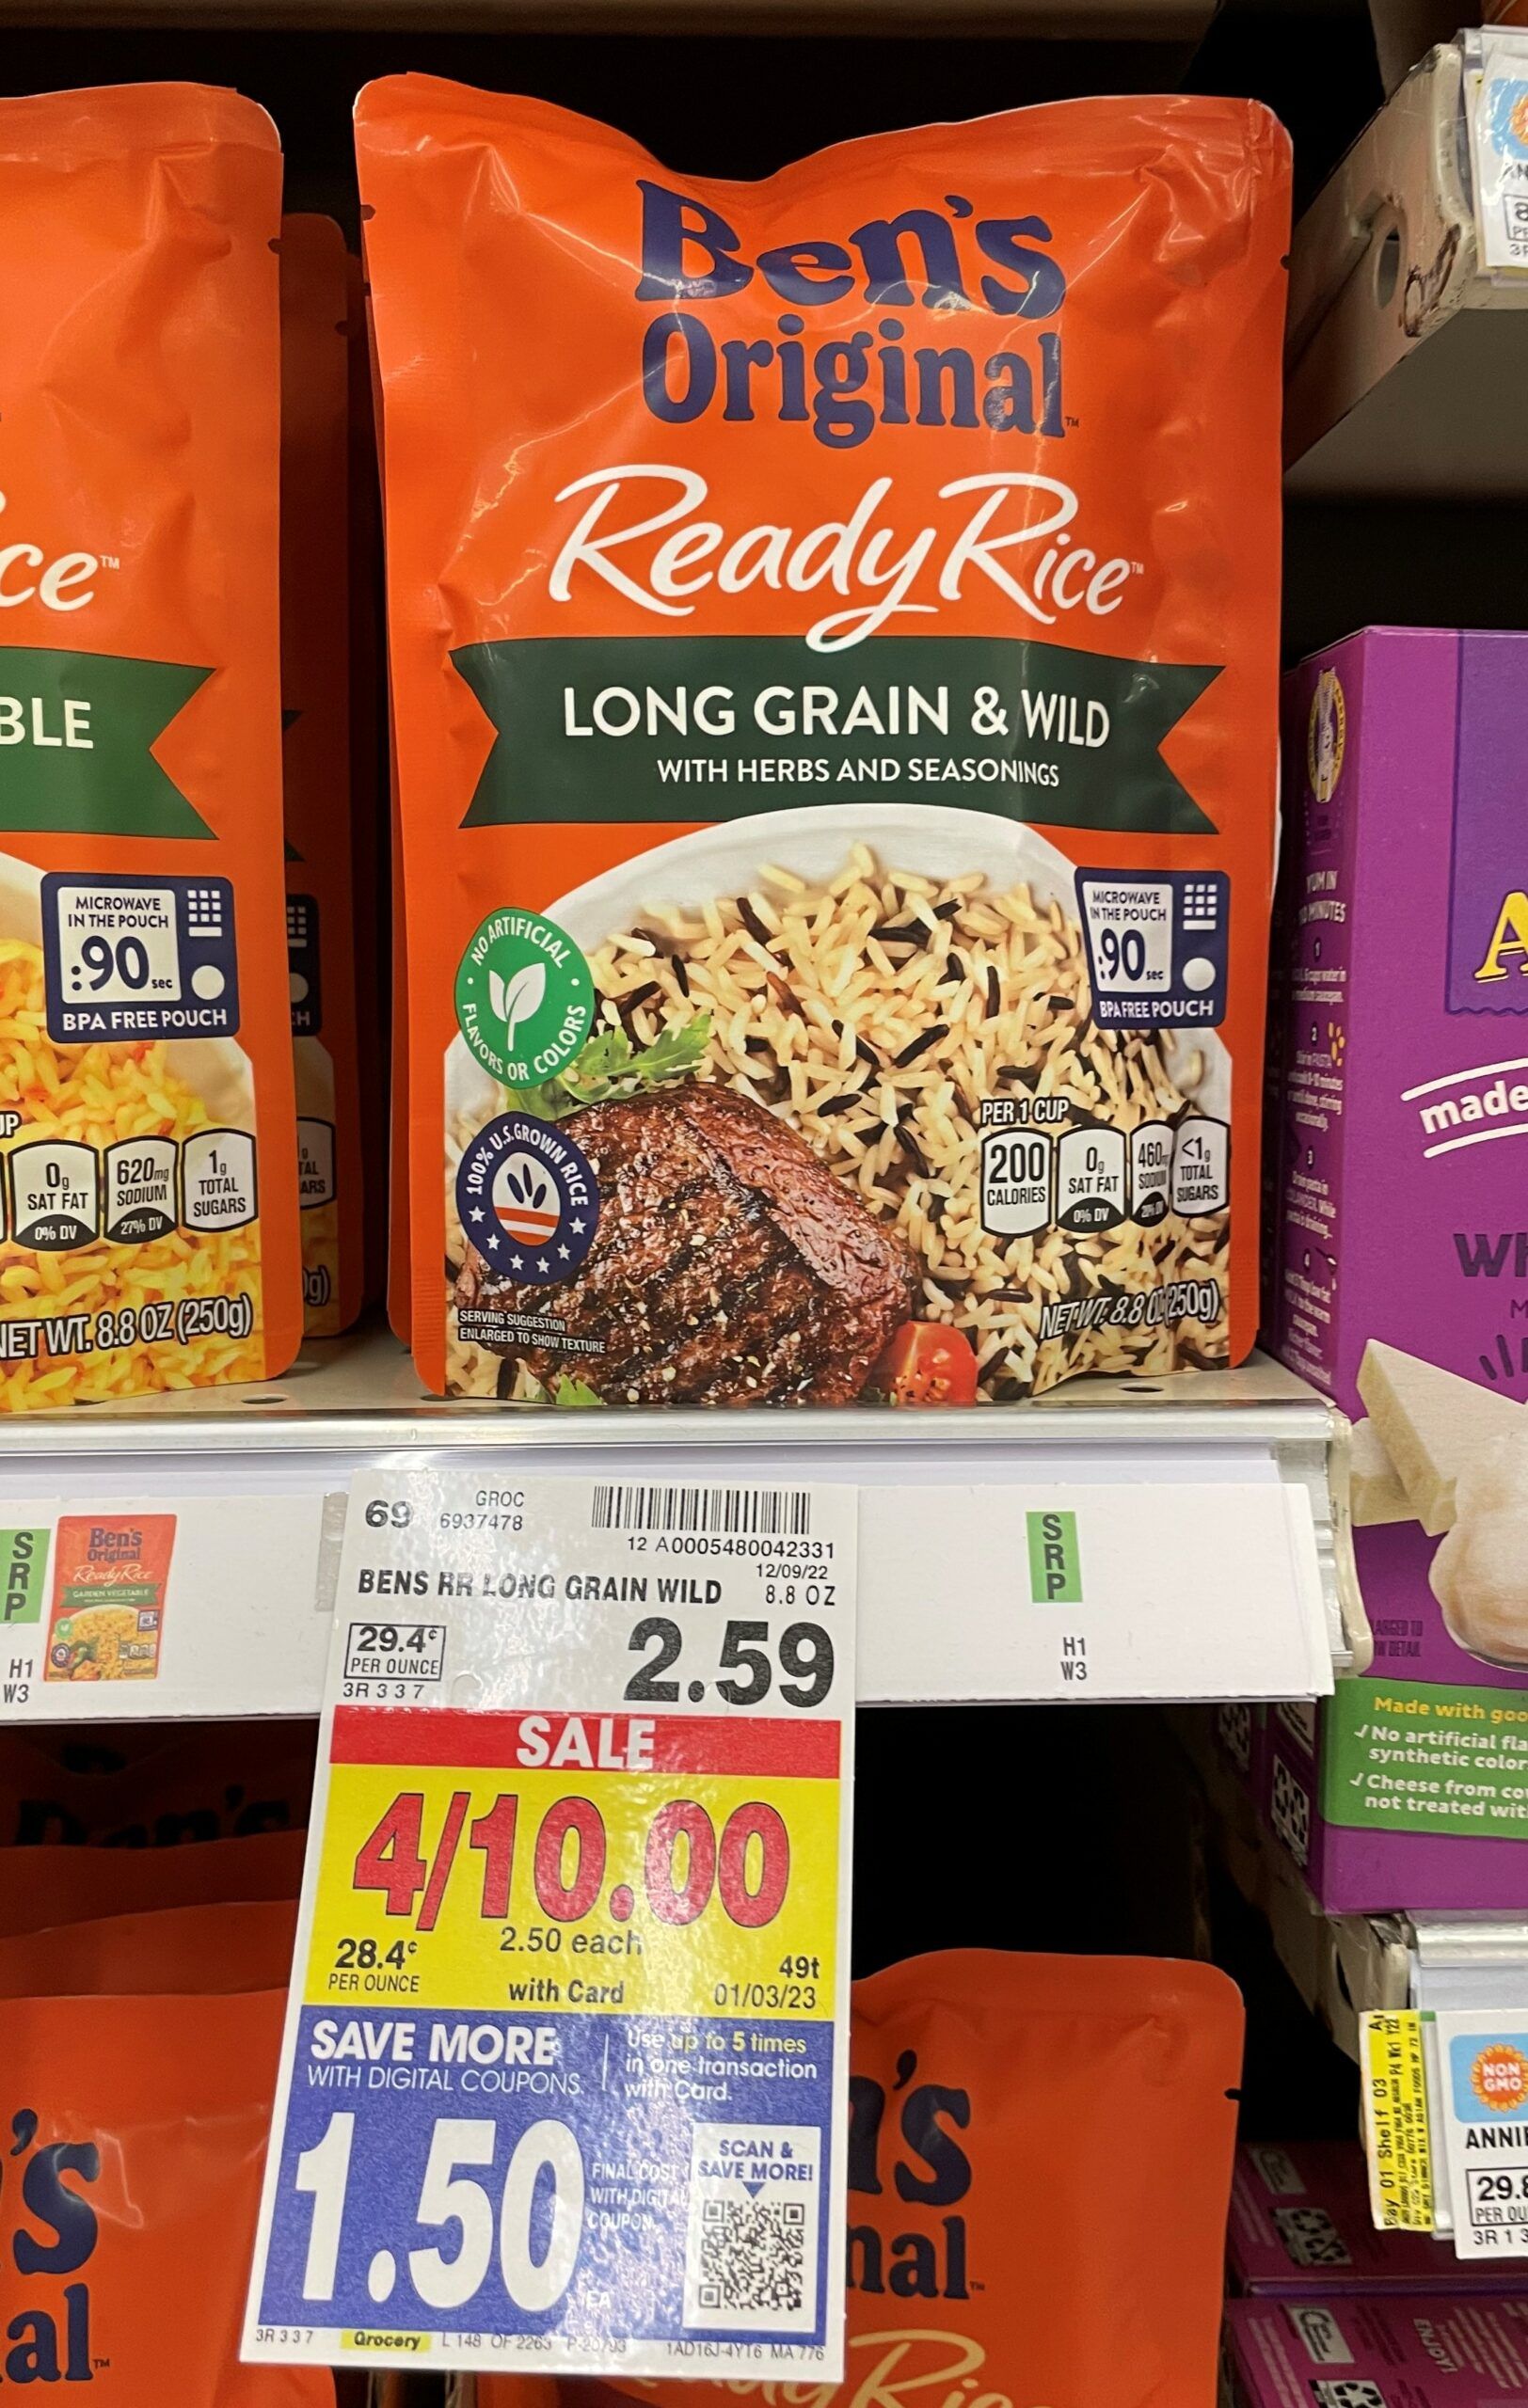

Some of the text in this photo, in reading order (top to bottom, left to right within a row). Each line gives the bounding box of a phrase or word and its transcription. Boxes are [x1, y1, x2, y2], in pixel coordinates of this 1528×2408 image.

[636, 180, 1066, 319] Ben's
[643, 313, 1065, 450] Original
[549, 464, 1131, 654] Ready Rice
[565, 686, 1110, 749] LONG GRAIN & WILD
[658, 758, 1059, 787] WITH HERBS AND SEASONINGS
[75, 896, 161, 912] MICROWAVE
[1093, 891, 1160, 905] MICROWAVE
[68, 914, 168, 928] IN THE POUCH
[1103, 909, 1167, 921] THE POUCH
[471, 916, 571, 969] NO ARTIFICIAL
[151, 977, 172, 990] sec
[1146, 970, 1164, 980] sec
[1099, 1000, 1214, 1018] BPA FREE POUCH
[62, 1009, 227, 1031] BPA FREE POUCH
[462, 1003, 586, 1081] FLAVORS OR COLORS
[981, 1099, 1069, 1123] PER 1 CUP
[1420, 1080, 1528, 1133] made
[117, 1158, 169, 1185] 620mg
[989, 1142, 1044, 1183] 200
[1180, 1164, 1213, 1180] TOTAL
[199, 1178, 239, 1195] TOTAL
[466, 1146, 589, 1207] 100% RICE
[1069, 1176, 1119, 1195] SAT FAT
[27, 1193, 88, 1211] SAT FAT
[117, 1184, 167, 1207] SODIUM
[988, 1186, 1045, 1206] CALORIES
[1177, 1185, 1218, 1202] SUGARS
[193, 1197, 247, 1217] SUGARS
[1074, 1208, 1109, 1223] 0% DV
[35, 1225, 77, 1241] 0% DV
[120, 1216, 163, 1235] 27% DV
[45, 1294, 253, 1352] WT. 8.8 OZ (250g)
[459, 1310, 565, 1332] SERVING SUGGESTION
[1040, 1294, 1145, 1339] NET 8.8
[460, 1330, 606, 1354] ENLARGED TO SHOW TEXTURE
[476, 1491, 524, 1508] GROC
[365, 1500, 413, 1528] 69
[439, 1513, 523, 1531] 6937478
[89, 1528, 142, 1548] Ben's
[628, 1537, 835, 1559] 12 A0005480042331
[88, 1547, 140, 1563] Original
[756, 1564, 829, 1580] 12/09/22
[358, 1569, 722, 1604] BENS RR LONG GRAIN WILD
[765, 1585, 795, 1604] 8.8
[1063, 1637, 1086, 1656] H1
[9, 1659, 33, 1678] H1
[351, 1658, 439, 1675] PER OUNCE
[624, 1617, 834, 1708] 2.59
[1060, 1661, 1088, 1680] W3
[4, 1685, 29, 1703] W3
[1374, 1697, 1486, 1719] Made with
[517, 1716, 656, 1766] SALE
[1371, 1725, 1496, 1751] No artificial
[1369, 1747, 1470, 1767] synthetic
[1366, 1773, 1496, 1798] Cheese from
[1365, 1796, 1486, 1816] not treated
[353, 1792, 789, 1930] 4/10.00
[500, 1927, 643, 1956] 2.50 each
[779, 1956, 820, 1979] 49t
[328, 1973, 420, 1992] PER OUNCE
[509, 1979, 624, 2004] with Card
[714, 1983, 816, 2010] 01/03/23
[310, 2020, 557, 2066] SAVE MORE
[628, 2030, 806, 2054] Use up to 5 times
[626, 2055, 817, 2079] in one transaction
[1483, 2063, 1520, 2077] NON
[308, 2066, 585, 2095] WITH DIGITAL COUPONS.
[624, 2080, 732, 2101] with Card.
[1373, 2079, 1387, 2098] 03
[1483, 2078, 1522, 2092] GMO
[1375, 2109, 1393, 2159] Shelf
[719, 2140, 793, 2159] SCAN &
[592, 2162, 678, 2180] FINAL COST
[698, 2162, 813, 2181] SAVE MORE!
[1380, 2171, 1394, 2188] 01
[591, 2187, 628, 2205] WITH
[295, 2111, 585, 2312] 1.50
[1476, 2208, 1503, 2223] PER
[1474, 2230, 1498, 2245] 3R
[586, 2290, 611, 2307] EA
[354, 2331, 422, 2351] Grocery
[457, 2335, 512, 2349] 148 OF
